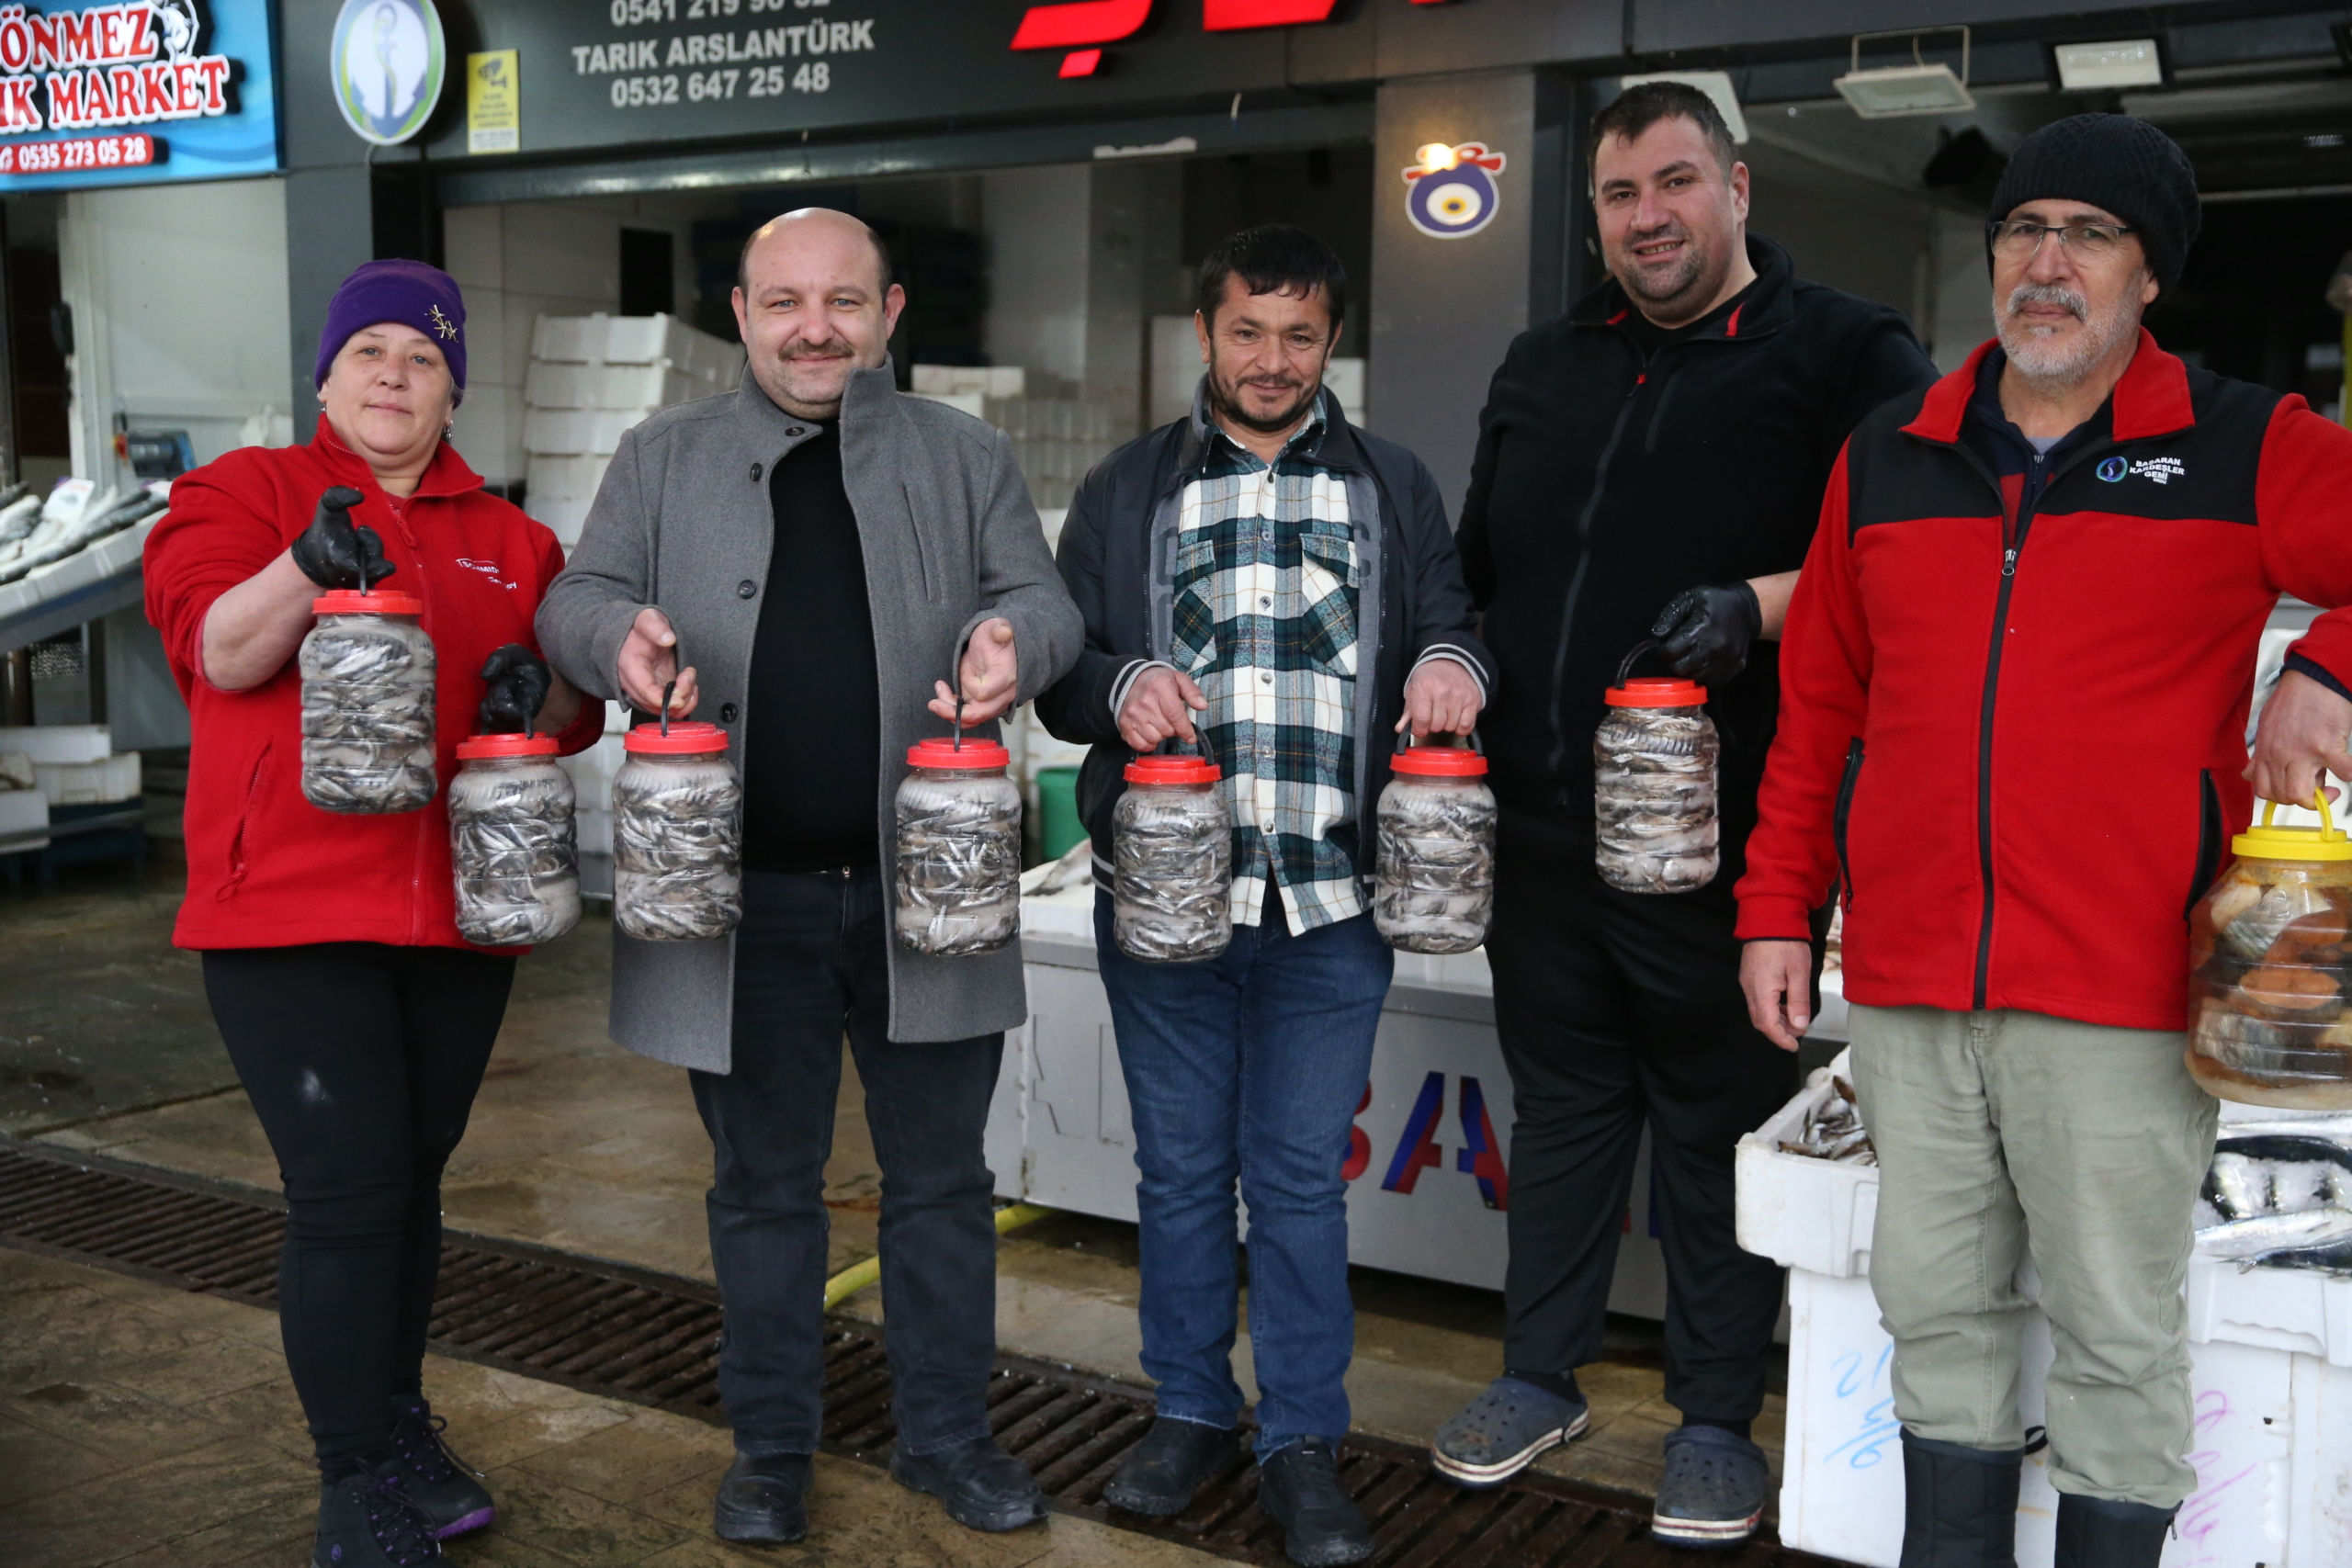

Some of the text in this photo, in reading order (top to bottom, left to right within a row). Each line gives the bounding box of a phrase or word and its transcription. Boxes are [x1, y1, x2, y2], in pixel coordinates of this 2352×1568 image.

[0, 3, 159, 73] ÖNMEZ
[571, 18, 876, 75] TARIK ARSLANTÜRK
[0, 54, 230, 134] IK MARKET
[610, 62, 831, 108] 0532 647 25 48
[18, 136, 147, 171] 0535 273 05 28
